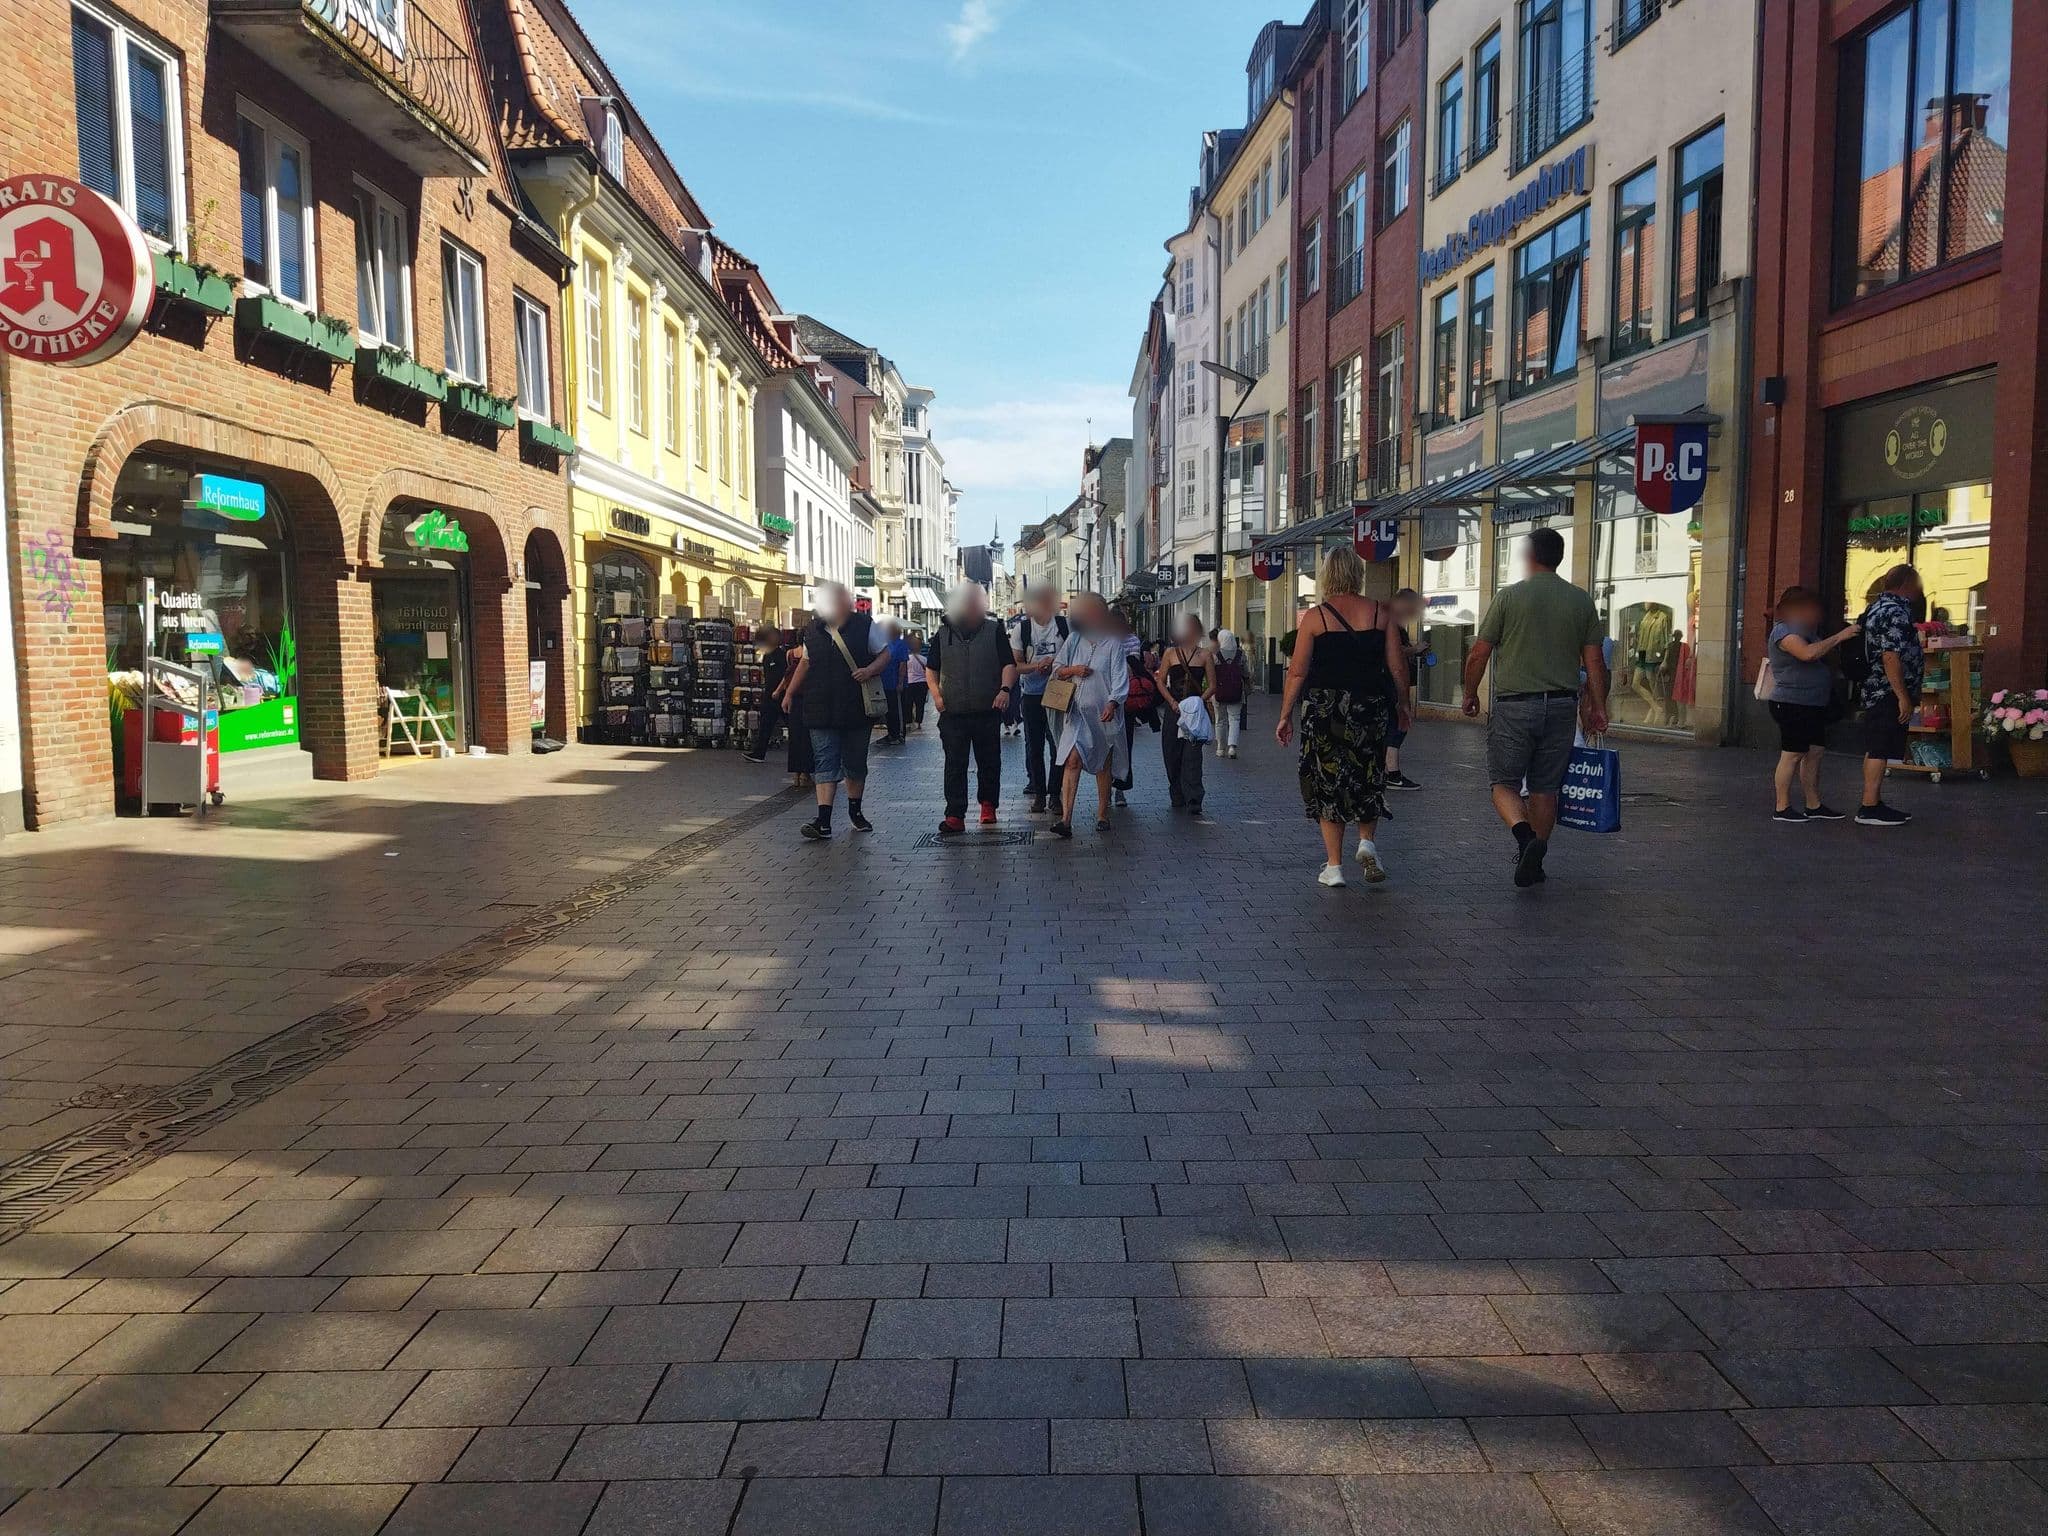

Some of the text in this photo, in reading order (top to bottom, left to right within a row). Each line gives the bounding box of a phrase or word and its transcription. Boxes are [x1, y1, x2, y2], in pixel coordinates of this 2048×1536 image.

[0, 180, 76, 208] RATS
[1642, 442, 1703, 482] P&C
[204, 486, 260, 511] Reformhaus
[1784, 489, 1795, 503] 28
[1357, 520, 1395, 542] P&C
[1254, 551, 1283, 567] P&C
[161, 590, 203, 609] Qualität
[162, 615, 179, 628] aus
[1568, 761, 1604, 777] schuh
[1561, 784, 1603, 800] eggers
